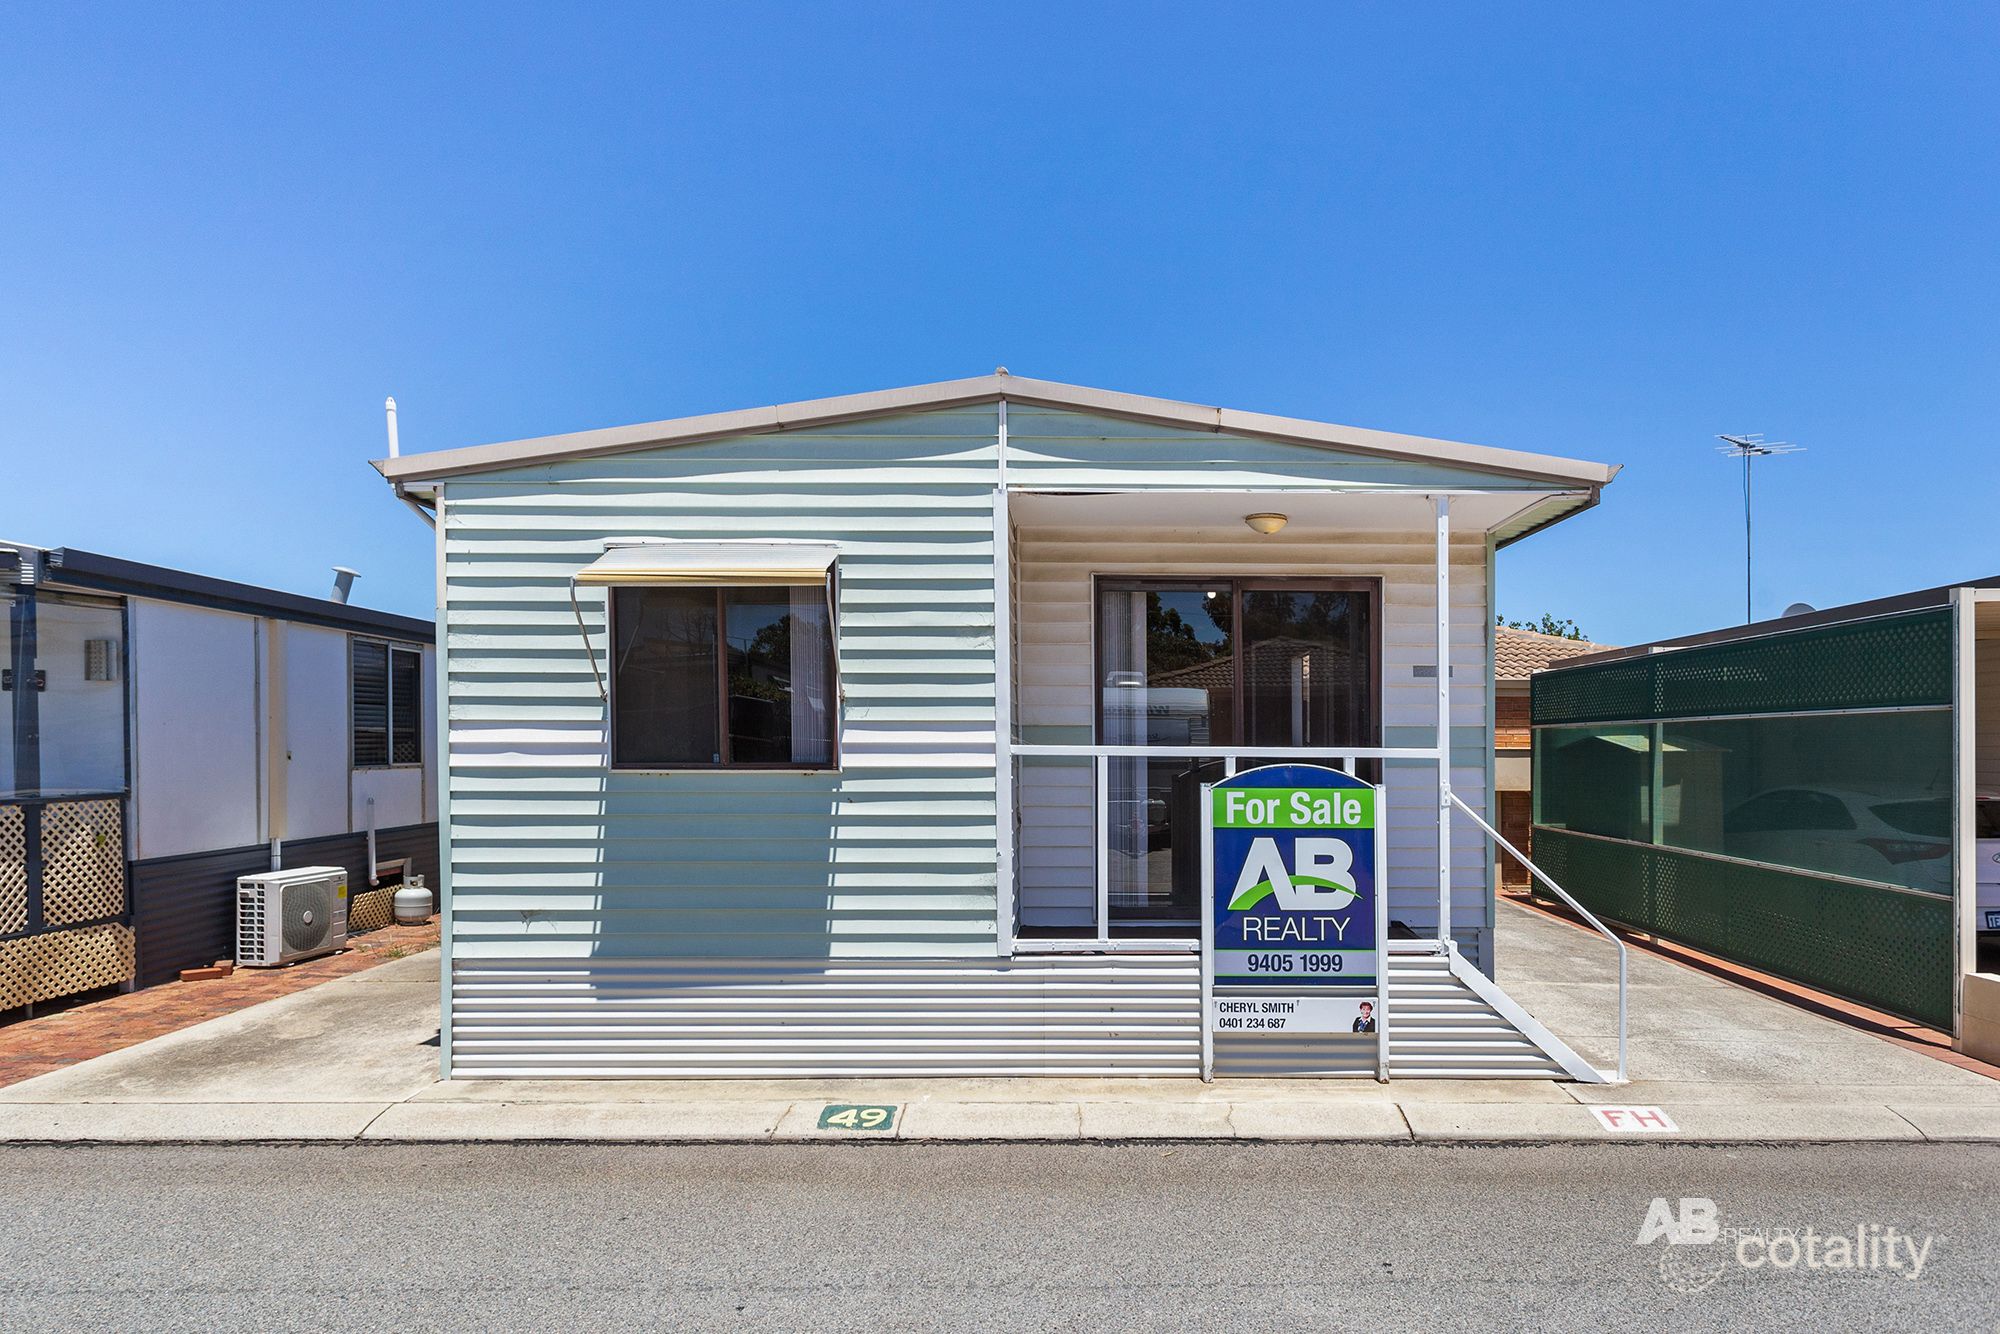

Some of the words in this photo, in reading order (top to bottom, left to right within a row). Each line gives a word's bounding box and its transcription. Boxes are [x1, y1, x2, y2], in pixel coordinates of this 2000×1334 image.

[1226, 792, 1280, 825] For
[1290, 791, 1361, 825] Sale
[1227, 837, 1358, 911] AB
[1243, 917, 1351, 941] REALTY
[1247, 953, 1293, 973] 9405
[1300, 953, 1343, 973] 1999
[1219, 1002, 1259, 1014] CHERYL
[1261, 1002, 1294, 1014] SMITH
[1219, 1018, 1243, 1029] 0401
[1246, 1018, 1265, 1029] 234
[1267, 1018, 1286, 1029] 687
[826, 1108, 888, 1128] 49
[1600, 1110, 1668, 1128] FH
